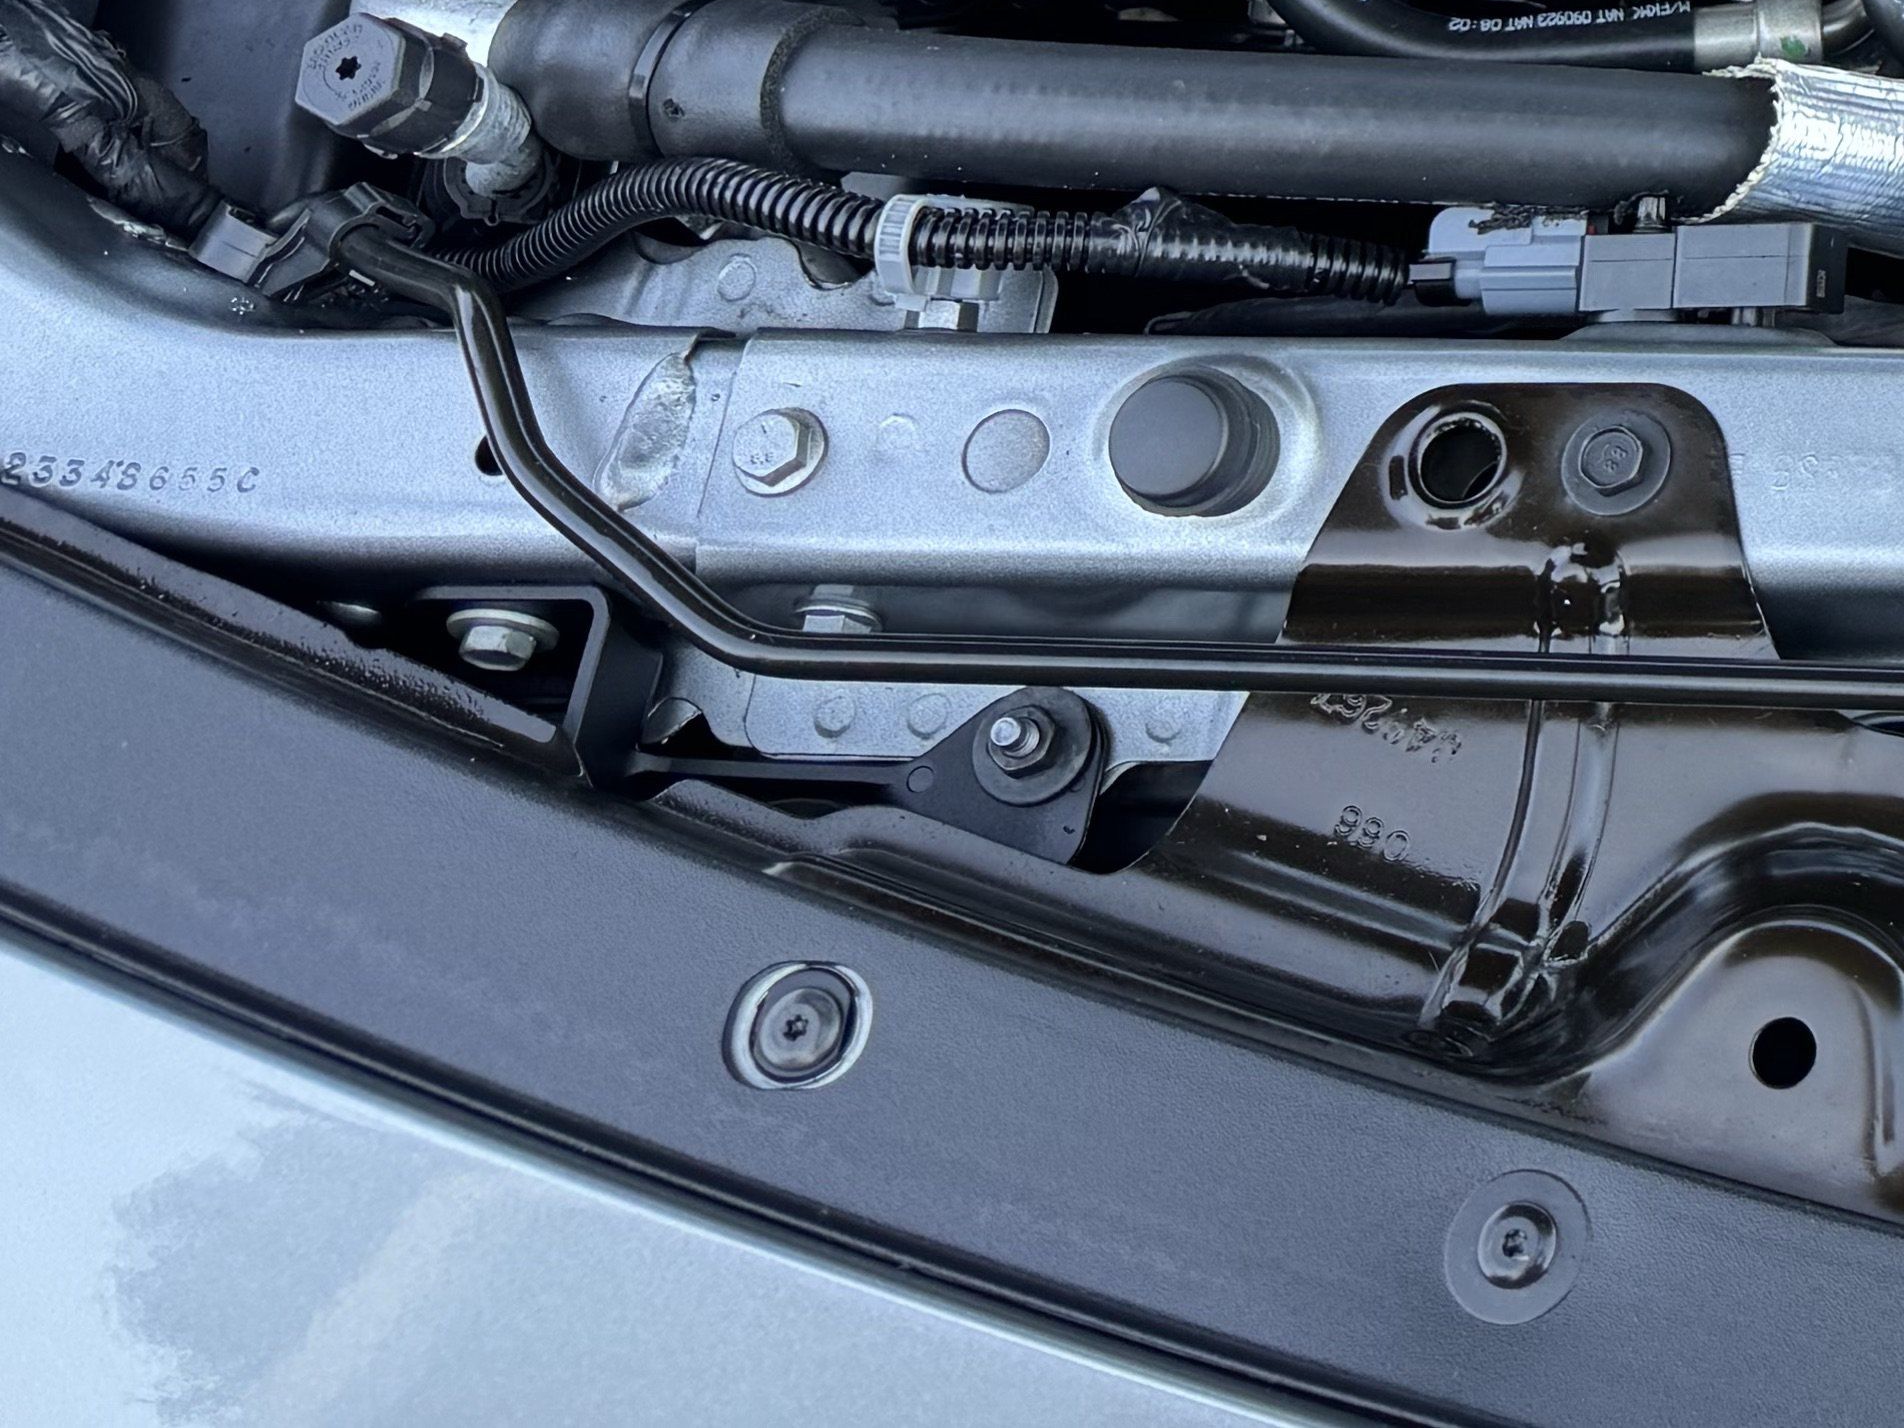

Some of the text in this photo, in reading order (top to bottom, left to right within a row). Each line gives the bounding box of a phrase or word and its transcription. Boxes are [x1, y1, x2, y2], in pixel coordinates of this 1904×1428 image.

[1504, 14, 1534, 31] NAT
[1536, 9, 1592, 28] 090923
[1595, 7, 1625, 23] NAT
[1448, 16, 1503, 33] 08:02
